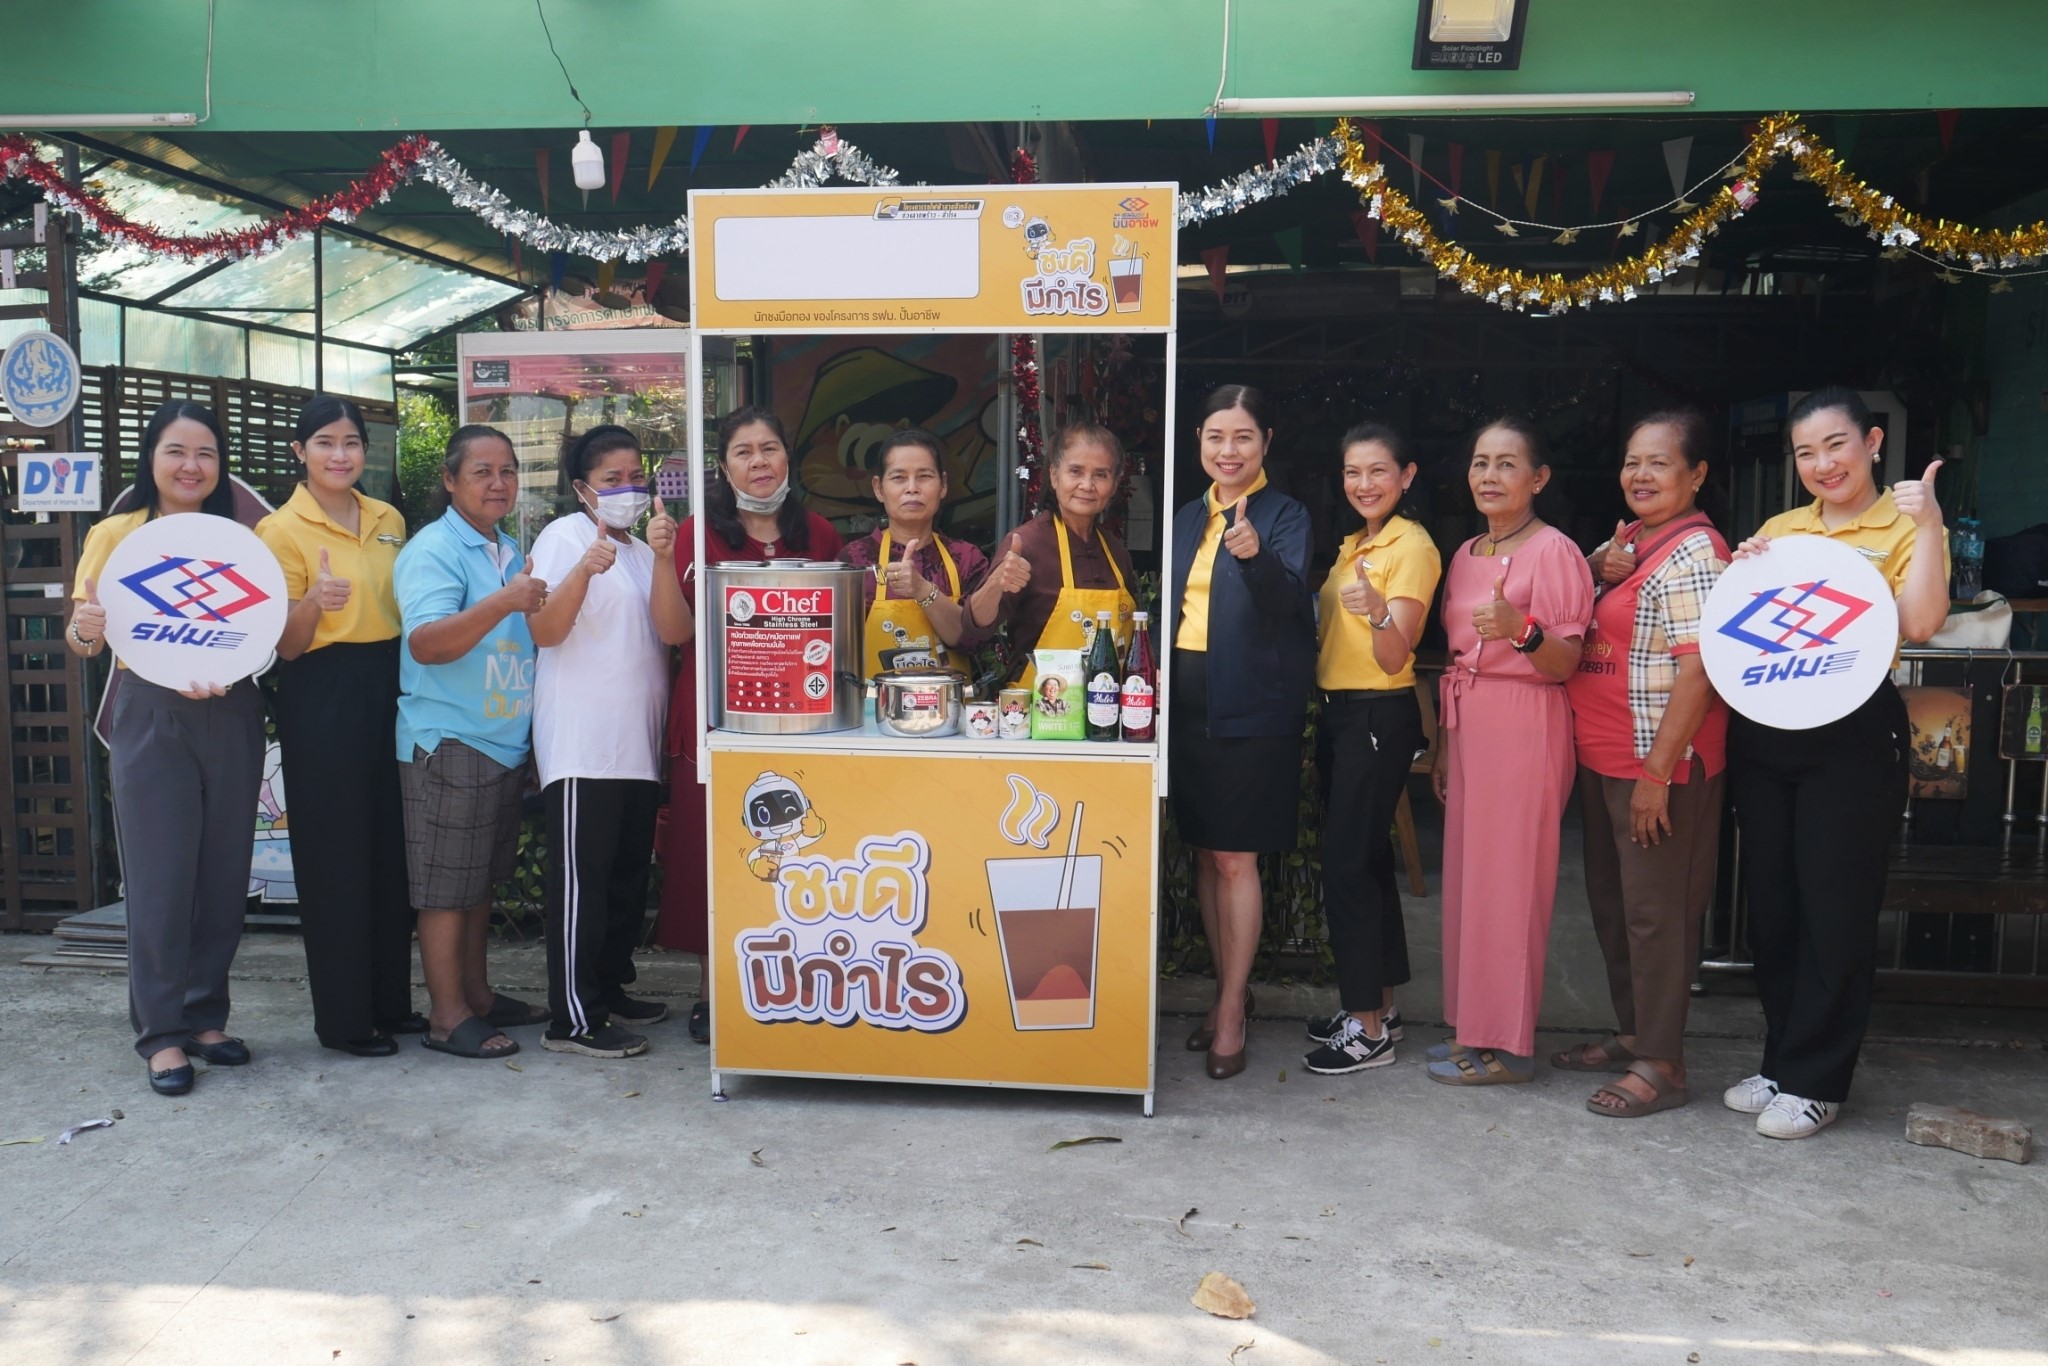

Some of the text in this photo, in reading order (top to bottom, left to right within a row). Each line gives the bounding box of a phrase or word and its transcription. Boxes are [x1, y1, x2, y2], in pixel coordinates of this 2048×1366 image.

[1478, 52, 1503, 63] LED
[1039, 242, 1091, 274] ชงดี
[1025, 279, 1104, 310] มีกำไร
[754, 310, 811, 323] นักชงมือทอง
[813, 309, 870, 322] ของโครงการ
[872, 309, 897, 321] รฟม.
[23, 457, 94, 494] DIT
[761, 590, 821, 613] Chef
[1583, 640, 1613, 658] ovely
[783, 844, 916, 922] ชงดี
[747, 933, 951, 1017] มีกำไร
